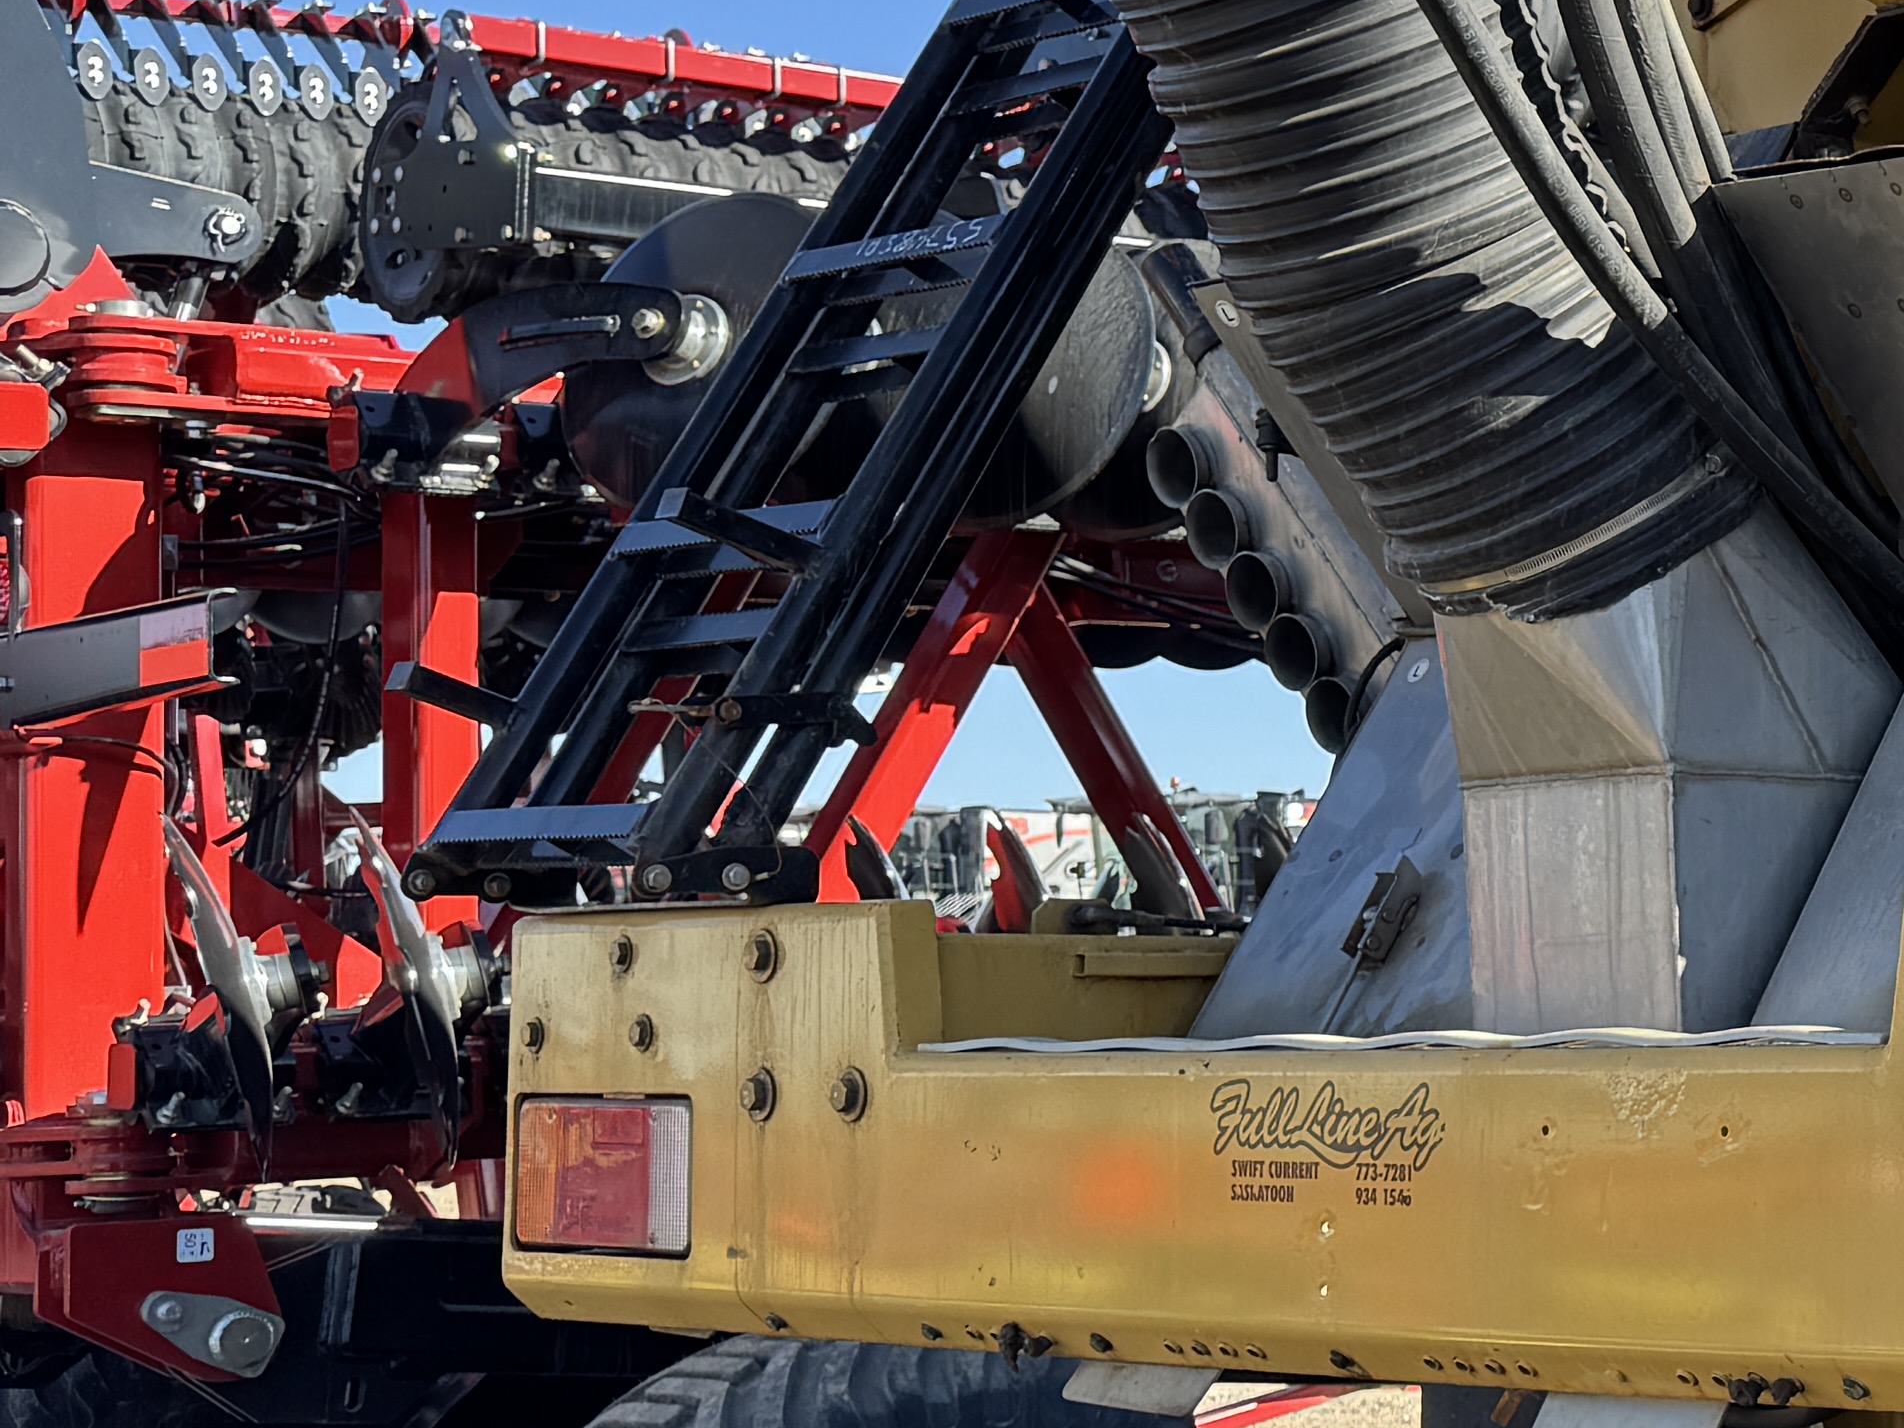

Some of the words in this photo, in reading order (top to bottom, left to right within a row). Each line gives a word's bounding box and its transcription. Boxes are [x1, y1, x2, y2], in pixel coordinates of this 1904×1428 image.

[1210, 1078, 1300, 1155] Full
[1298, 1080, 1383, 1169] Line
[1231, 1159, 1265, 1178] SWIFT
[1268, 1161, 1320, 1180] CURRENT
[1356, 1163, 1412, 1182] 773-7281
[1231, 1184, 1294, 1203] SASKATOON
[1356, 1188, 1377, 1206] 934
